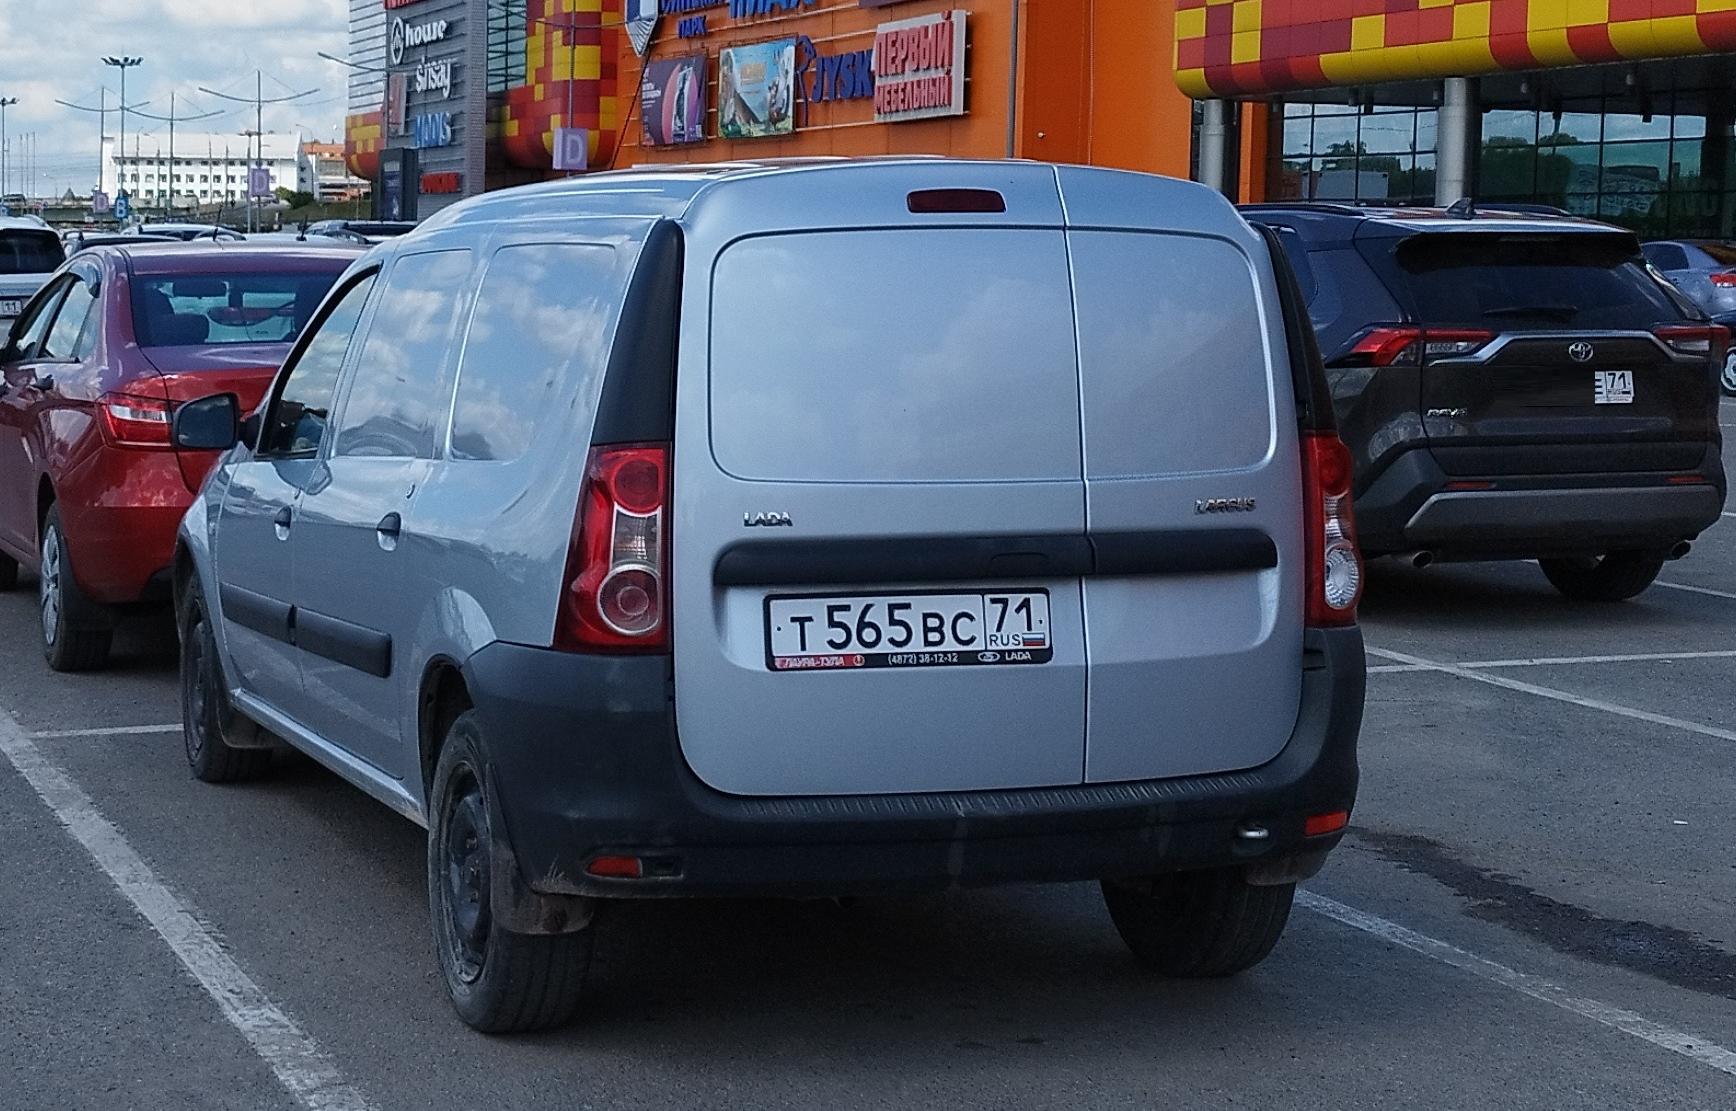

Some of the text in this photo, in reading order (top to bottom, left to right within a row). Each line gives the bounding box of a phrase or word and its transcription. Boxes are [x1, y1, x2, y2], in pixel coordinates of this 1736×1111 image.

[405, 20, 447, 48] house
[874, 11, 953, 77] ПЕРВЫЙ
[812, 49, 875, 103] JYSK
[874, 68, 953, 115] МЕБЕЛЬНЫЙ
[566, 137, 583, 165] D
[1607, 372, 1627, 389] 71
[743, 511, 793, 527] LADA
[989, 597, 1032, 632] 71
[989, 634, 1021, 646] RUS
[1005, 651, 1032, 661] LADA
